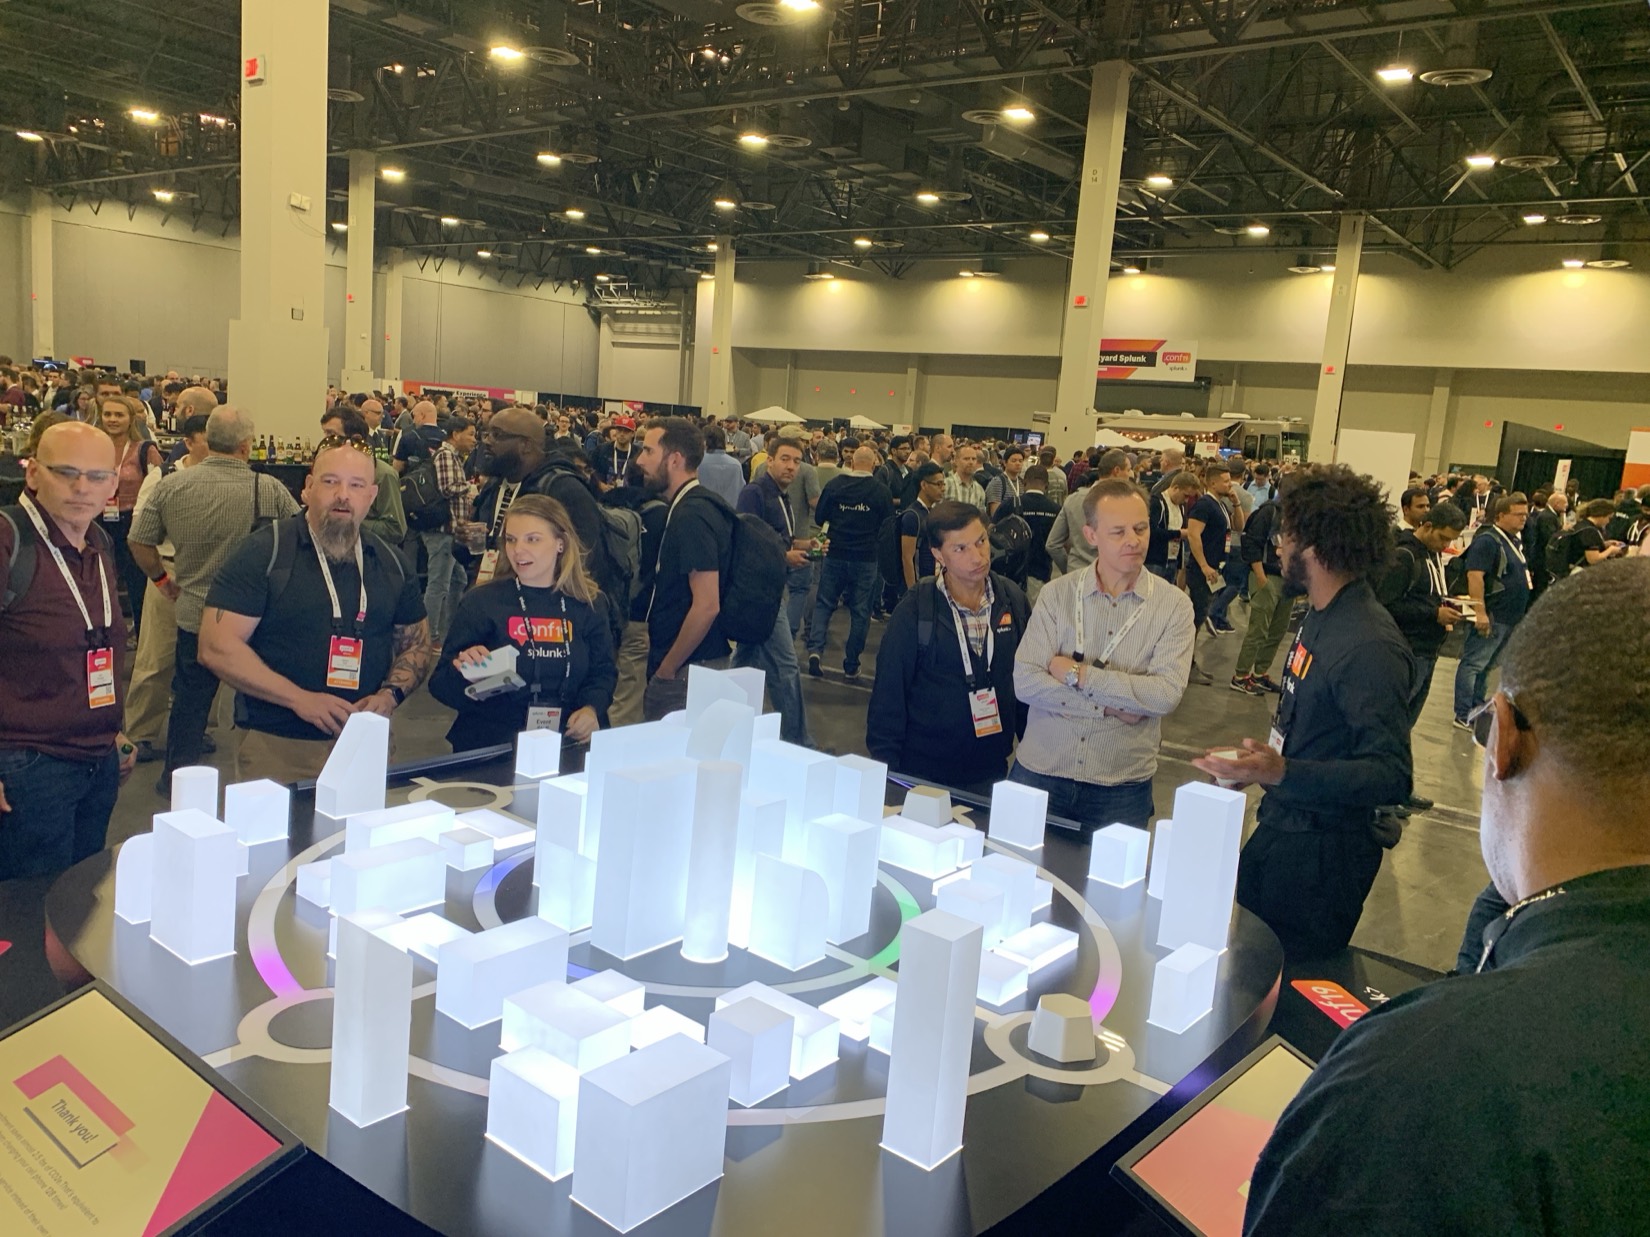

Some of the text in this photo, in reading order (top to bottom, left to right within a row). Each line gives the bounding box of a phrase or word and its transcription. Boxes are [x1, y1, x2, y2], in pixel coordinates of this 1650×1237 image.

[1099, 354, 1147, 363] yard Splunk
[456, 390, 486, 398] Experience
[513, 621, 565, 638] .conf1
[51, 1098, 99, 1144] Thank you!
